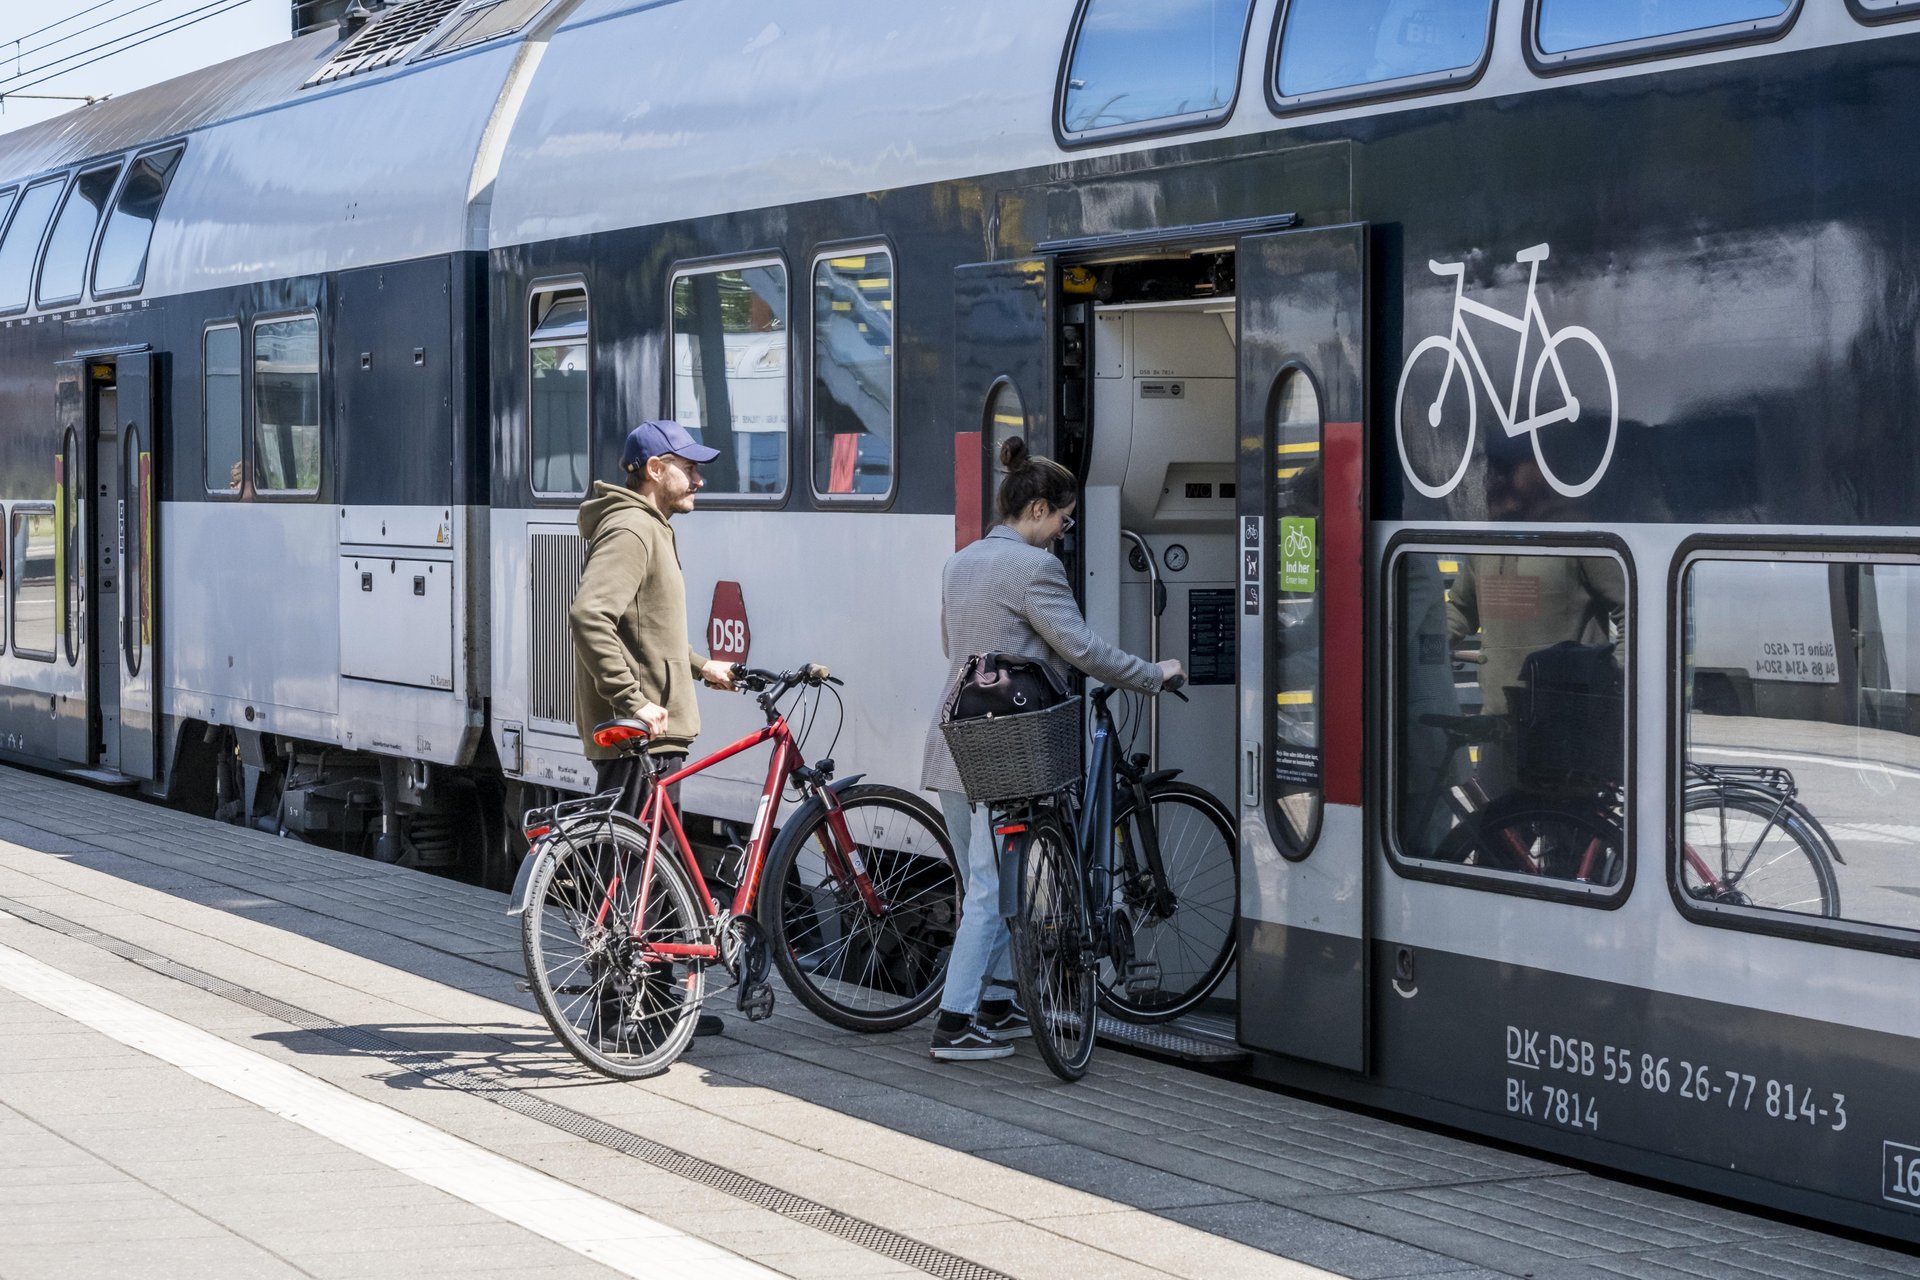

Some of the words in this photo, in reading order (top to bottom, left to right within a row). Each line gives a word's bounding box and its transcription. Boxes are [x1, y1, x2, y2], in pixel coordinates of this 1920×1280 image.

[1186, 485, 1210, 497] WC
[1286, 561, 1297, 573] Ind
[1298, 561, 1310, 573] her
[713, 618, 745, 653] DSB
[1507, 1025, 1595, 1076] DK-DSB
[1603, 1045, 1632, 1084] 55
[1640, 1053, 1671, 1093] 86
[1679, 1061, 1756, 1111] 26-77
[1765, 1079, 1847, 1131] 814-3
[1507, 1077, 1533, 1116] Bk
[1542, 1085, 1598, 1131] 7814
[1893, 1155, 1920, 1197] 16
